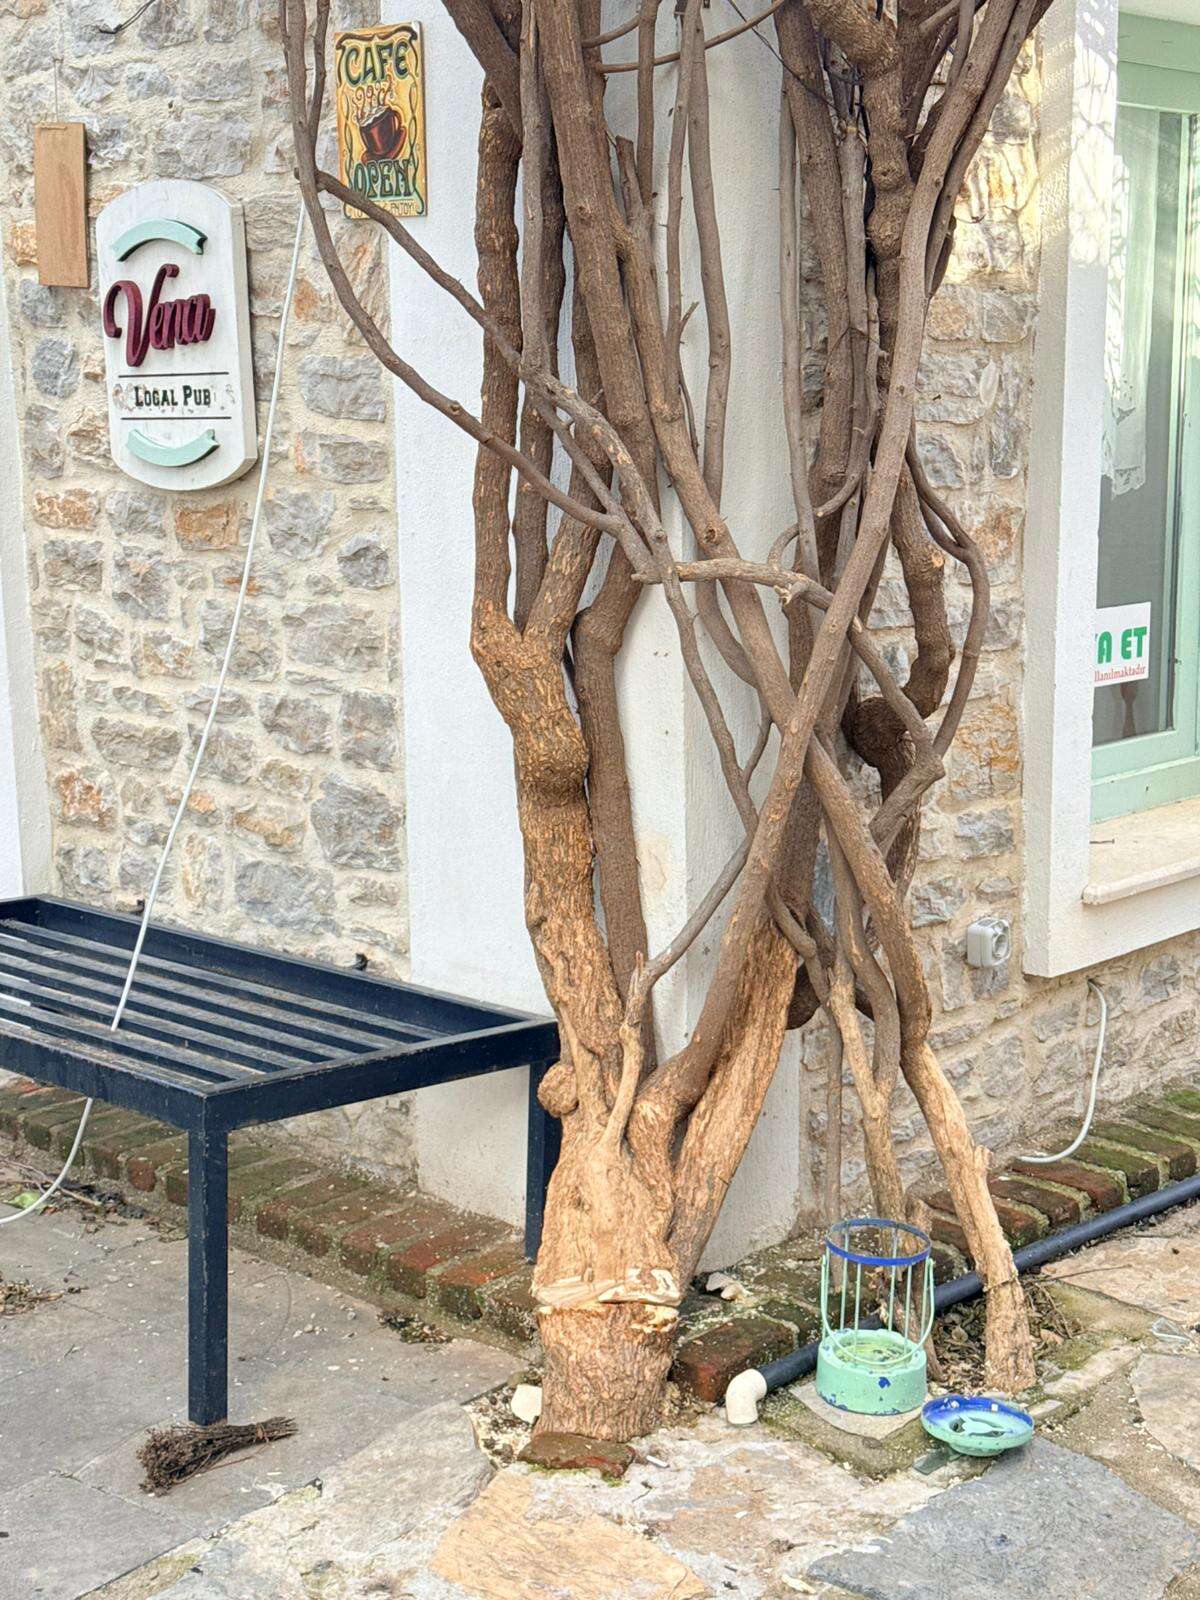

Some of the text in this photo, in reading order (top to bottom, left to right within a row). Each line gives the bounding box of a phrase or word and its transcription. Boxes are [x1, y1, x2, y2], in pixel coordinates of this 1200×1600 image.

[345, 41, 410, 86] CAFE
[354, 159, 412, 197] OPEN
[104, 263, 216, 367] Vena
[182, 385, 211, 406] PUB
[1121, 626, 1147, 660] ET
